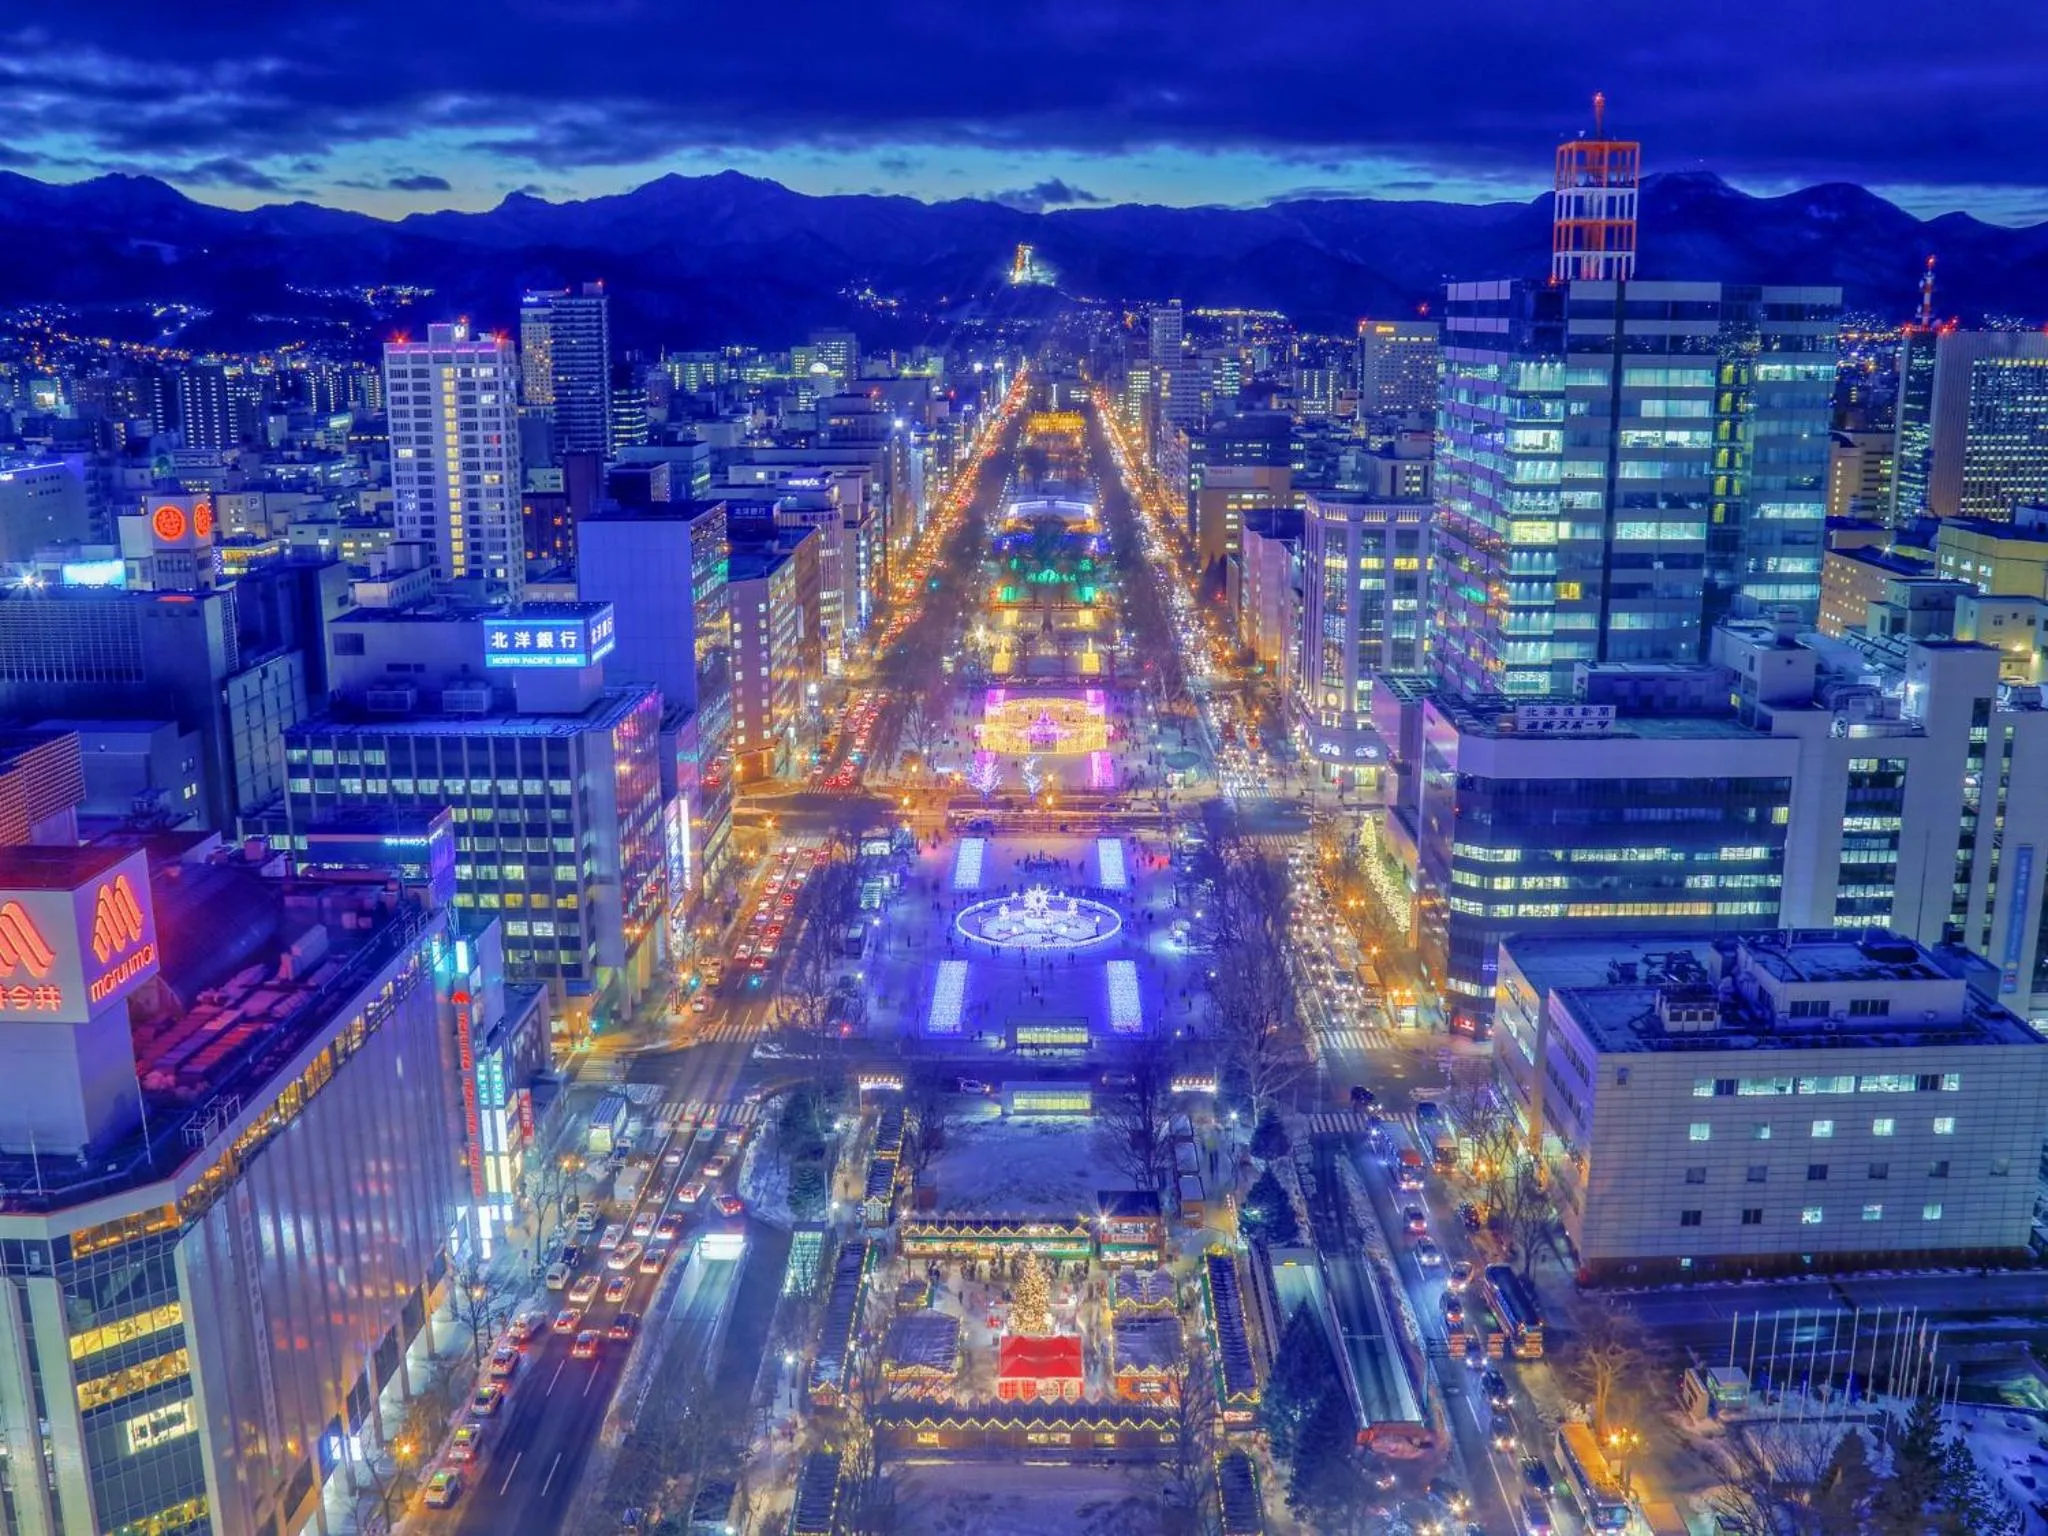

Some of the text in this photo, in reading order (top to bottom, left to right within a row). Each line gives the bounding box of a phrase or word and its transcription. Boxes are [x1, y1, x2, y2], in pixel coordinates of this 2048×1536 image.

[491, 631, 577, 649] 北洋銀行
[492, 656, 578, 665] NORTH PACIFIC BANK
[1526, 706, 1610, 718] 北海道新聞
